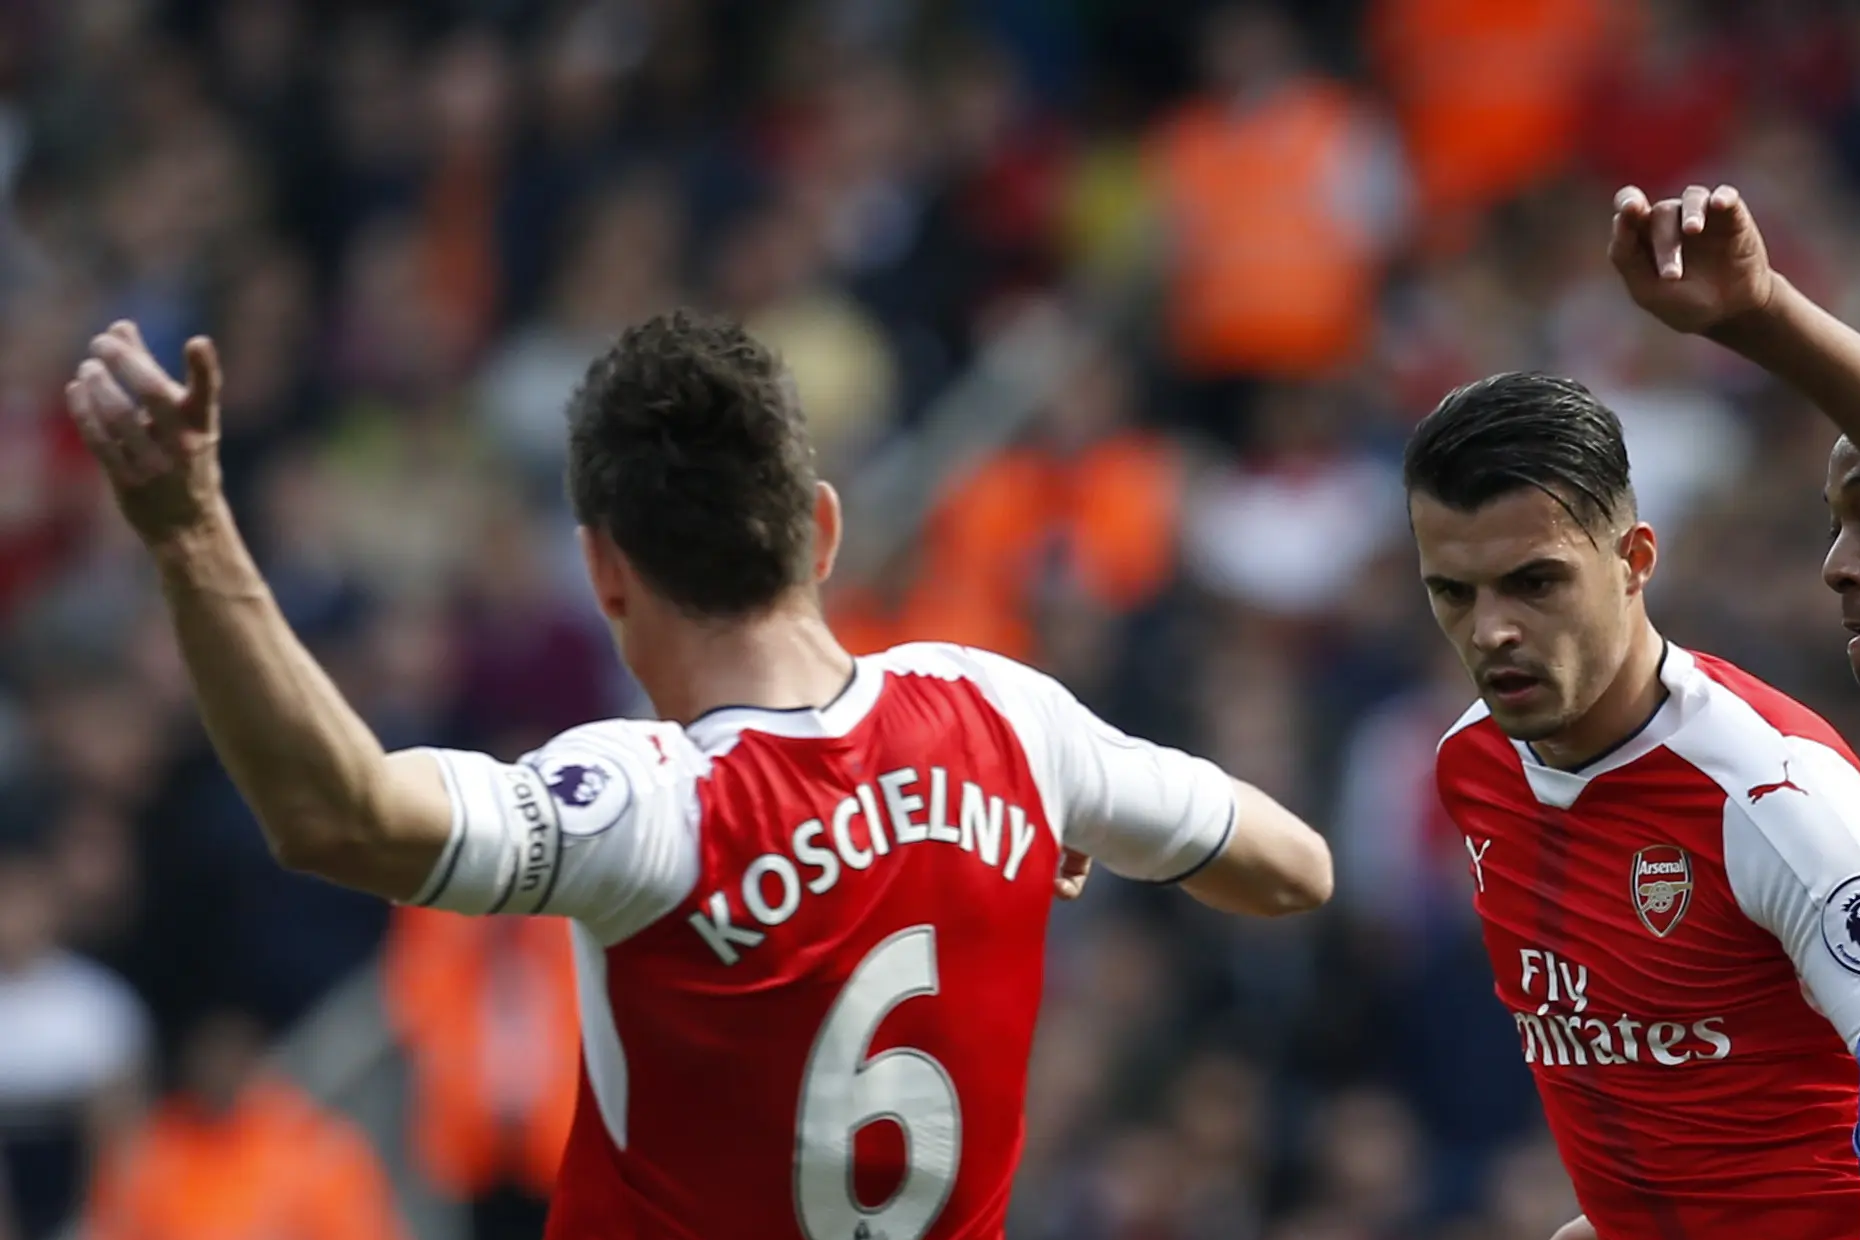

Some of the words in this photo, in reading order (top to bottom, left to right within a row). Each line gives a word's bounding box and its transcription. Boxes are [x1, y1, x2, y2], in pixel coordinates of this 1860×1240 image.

[687, 766, 1035, 966] KOSCIELNY
[1638, 859, 1685, 875] Arsenal
[1519, 949, 1588, 1013] Fly
[1514, 1002, 1732, 1066] mirates
